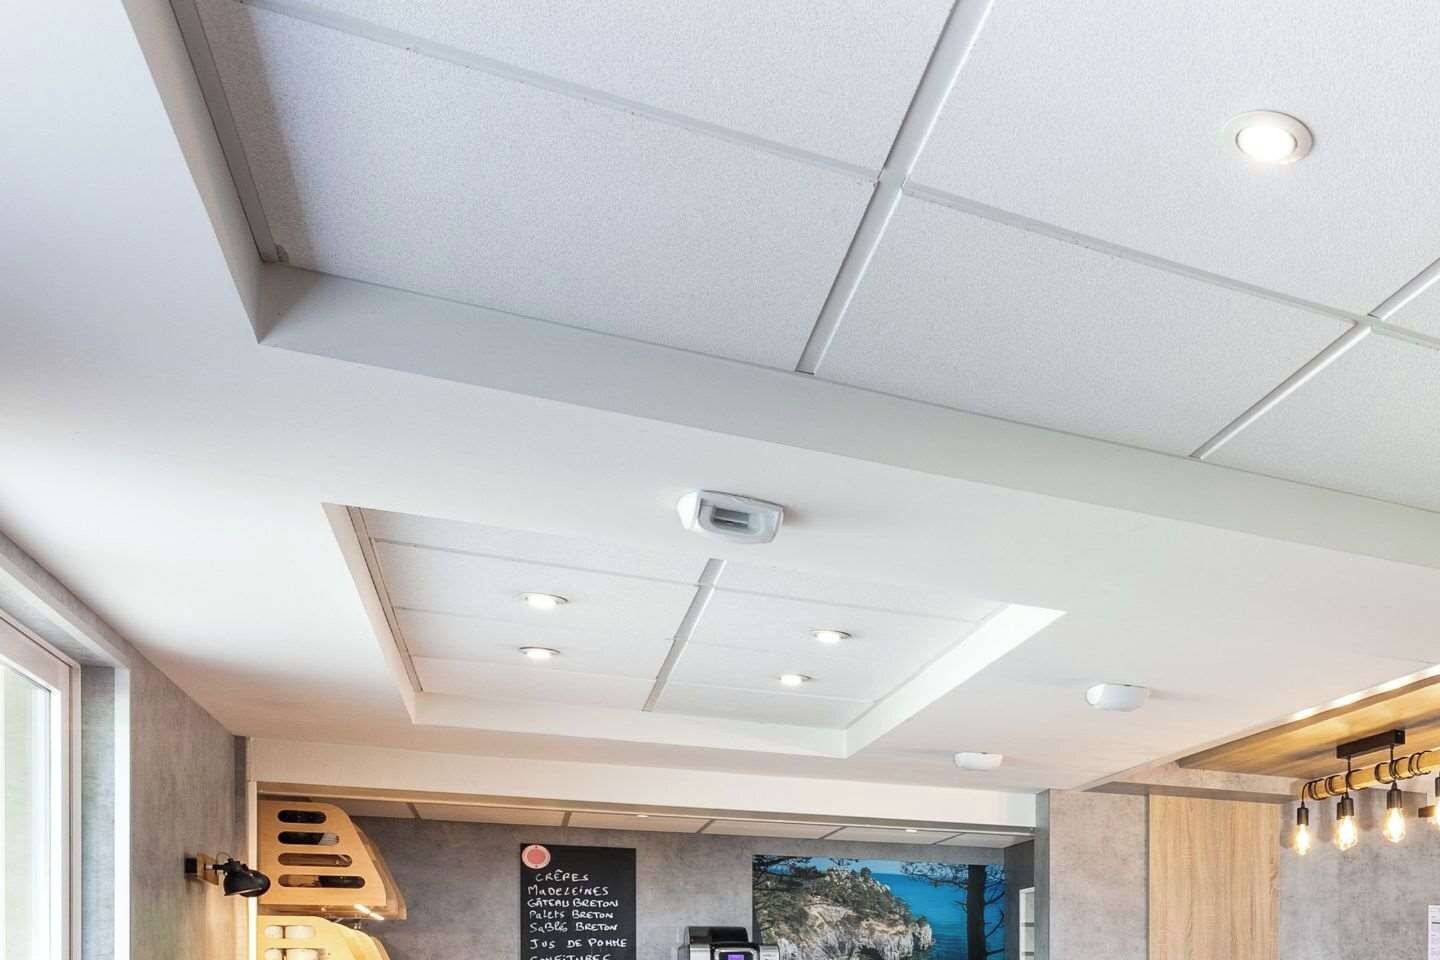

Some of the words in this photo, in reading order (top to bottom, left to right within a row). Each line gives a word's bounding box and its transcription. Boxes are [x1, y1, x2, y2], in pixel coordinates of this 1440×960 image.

[535, 869, 590, 882] CRÊPES
[572, 897, 619, 908] BRETON
[571, 909, 614, 919] BRETON
[575, 922, 618, 932] BRETON
[567, 938, 582, 948] DE
